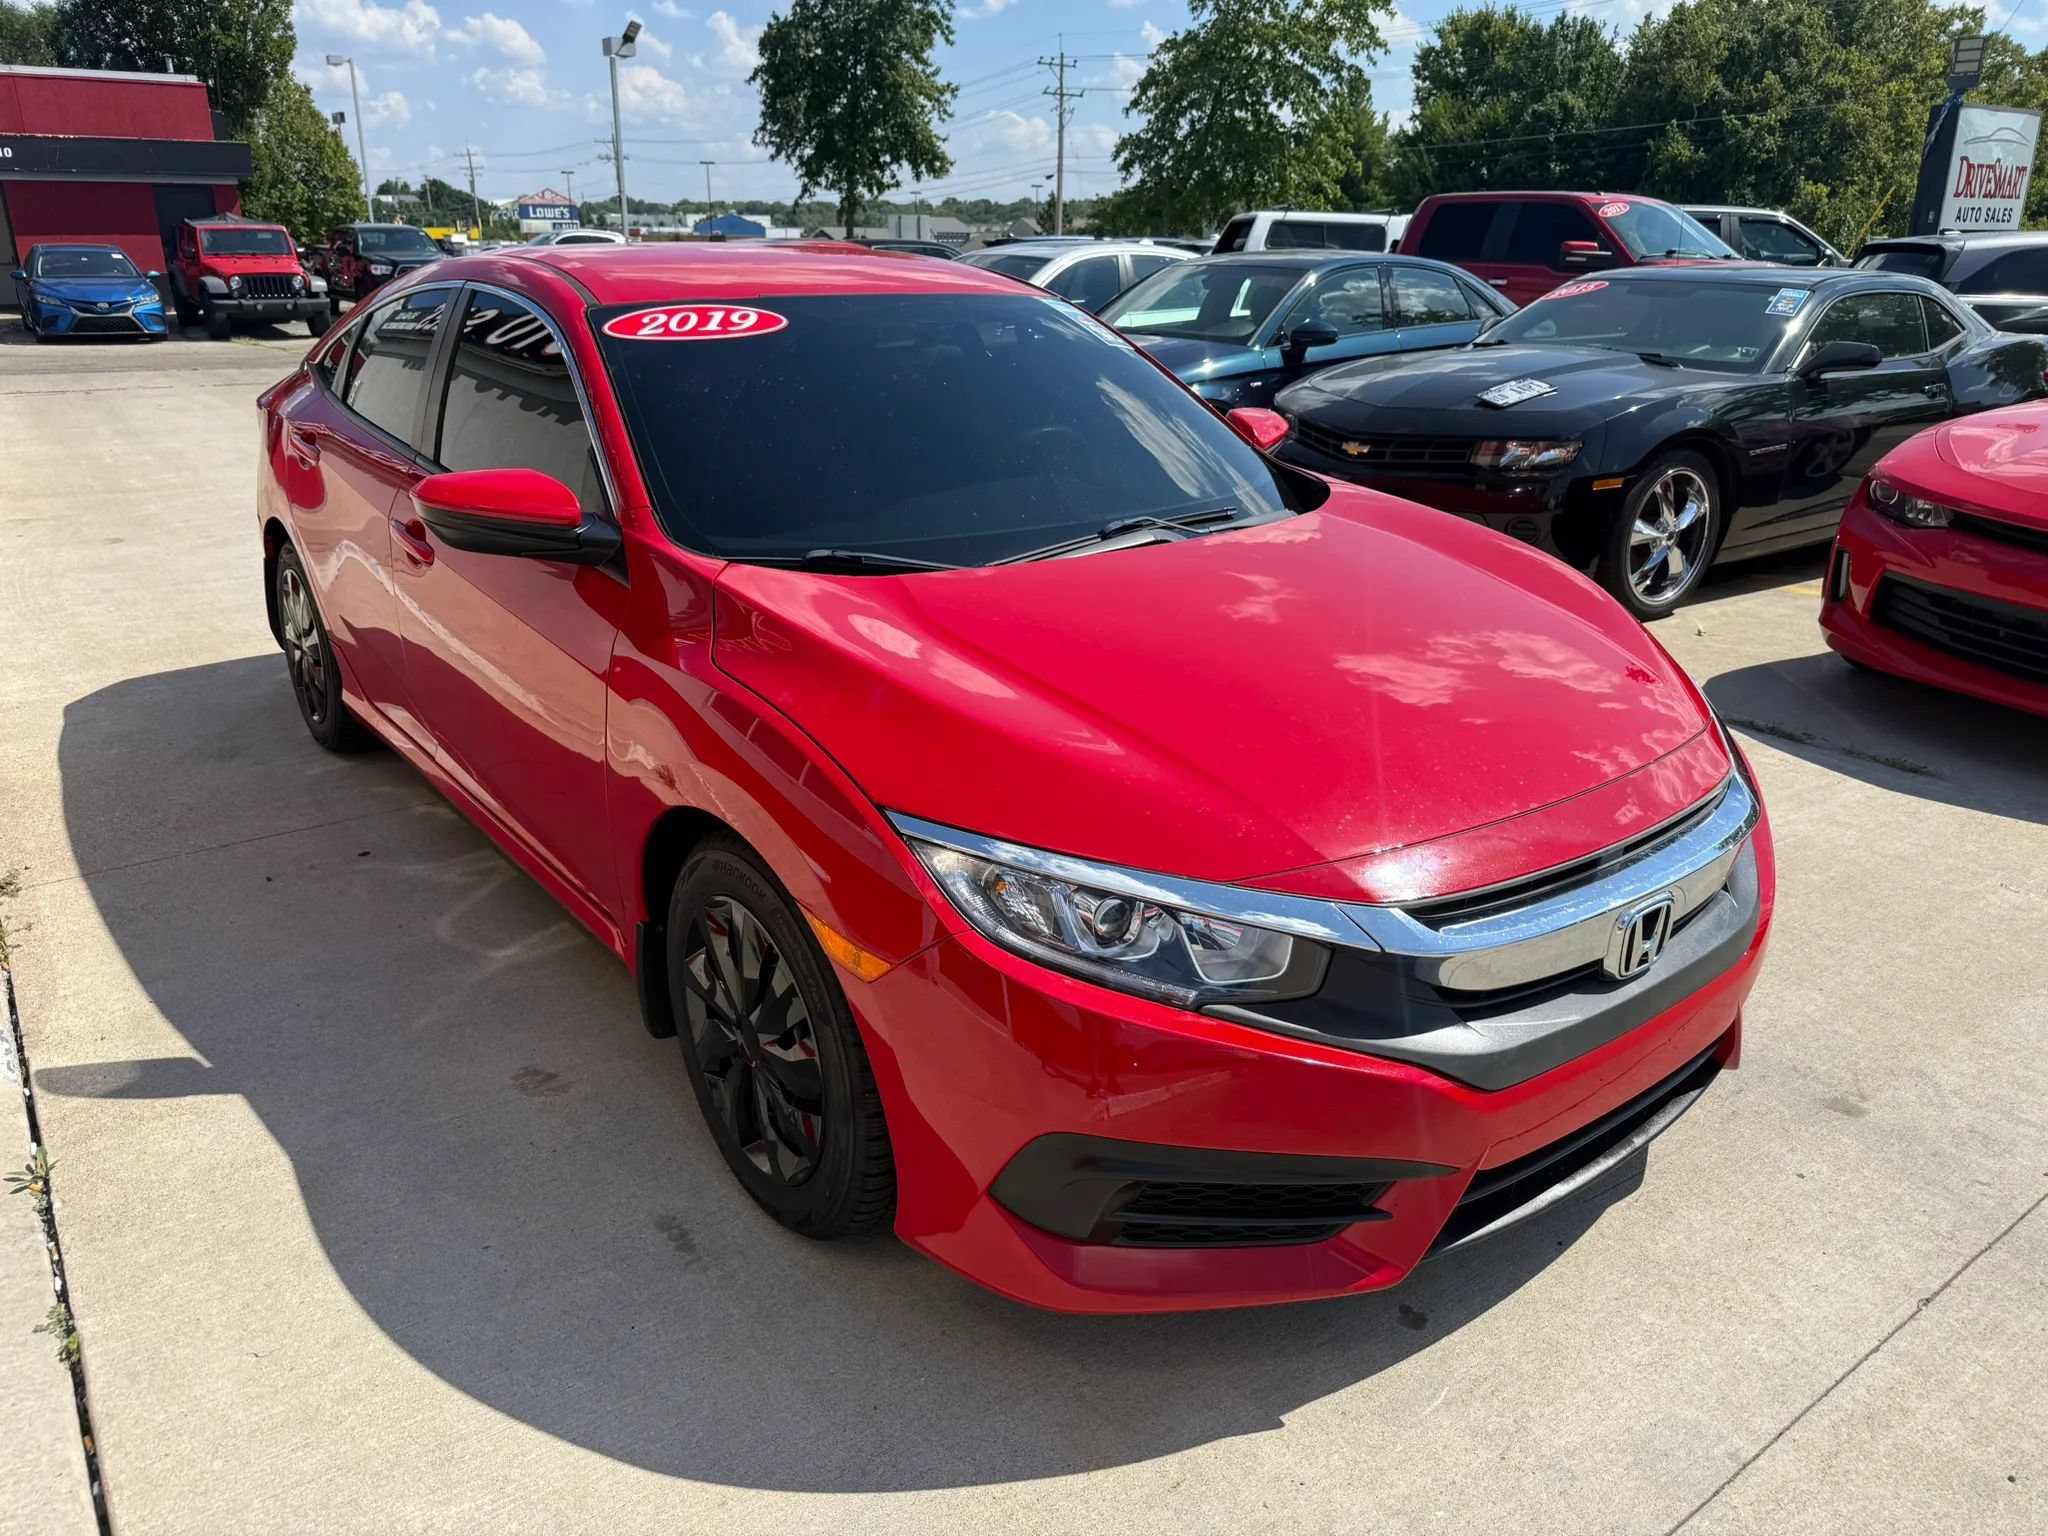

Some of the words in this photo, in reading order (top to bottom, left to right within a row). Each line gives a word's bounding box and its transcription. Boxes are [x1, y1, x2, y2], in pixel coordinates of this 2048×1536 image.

[528, 206, 570, 218] LOWE'S
[1955, 206, 1982, 223] AUTO
[1984, 207, 2013, 223] SALES
[636, 310, 759, 336] 2019
